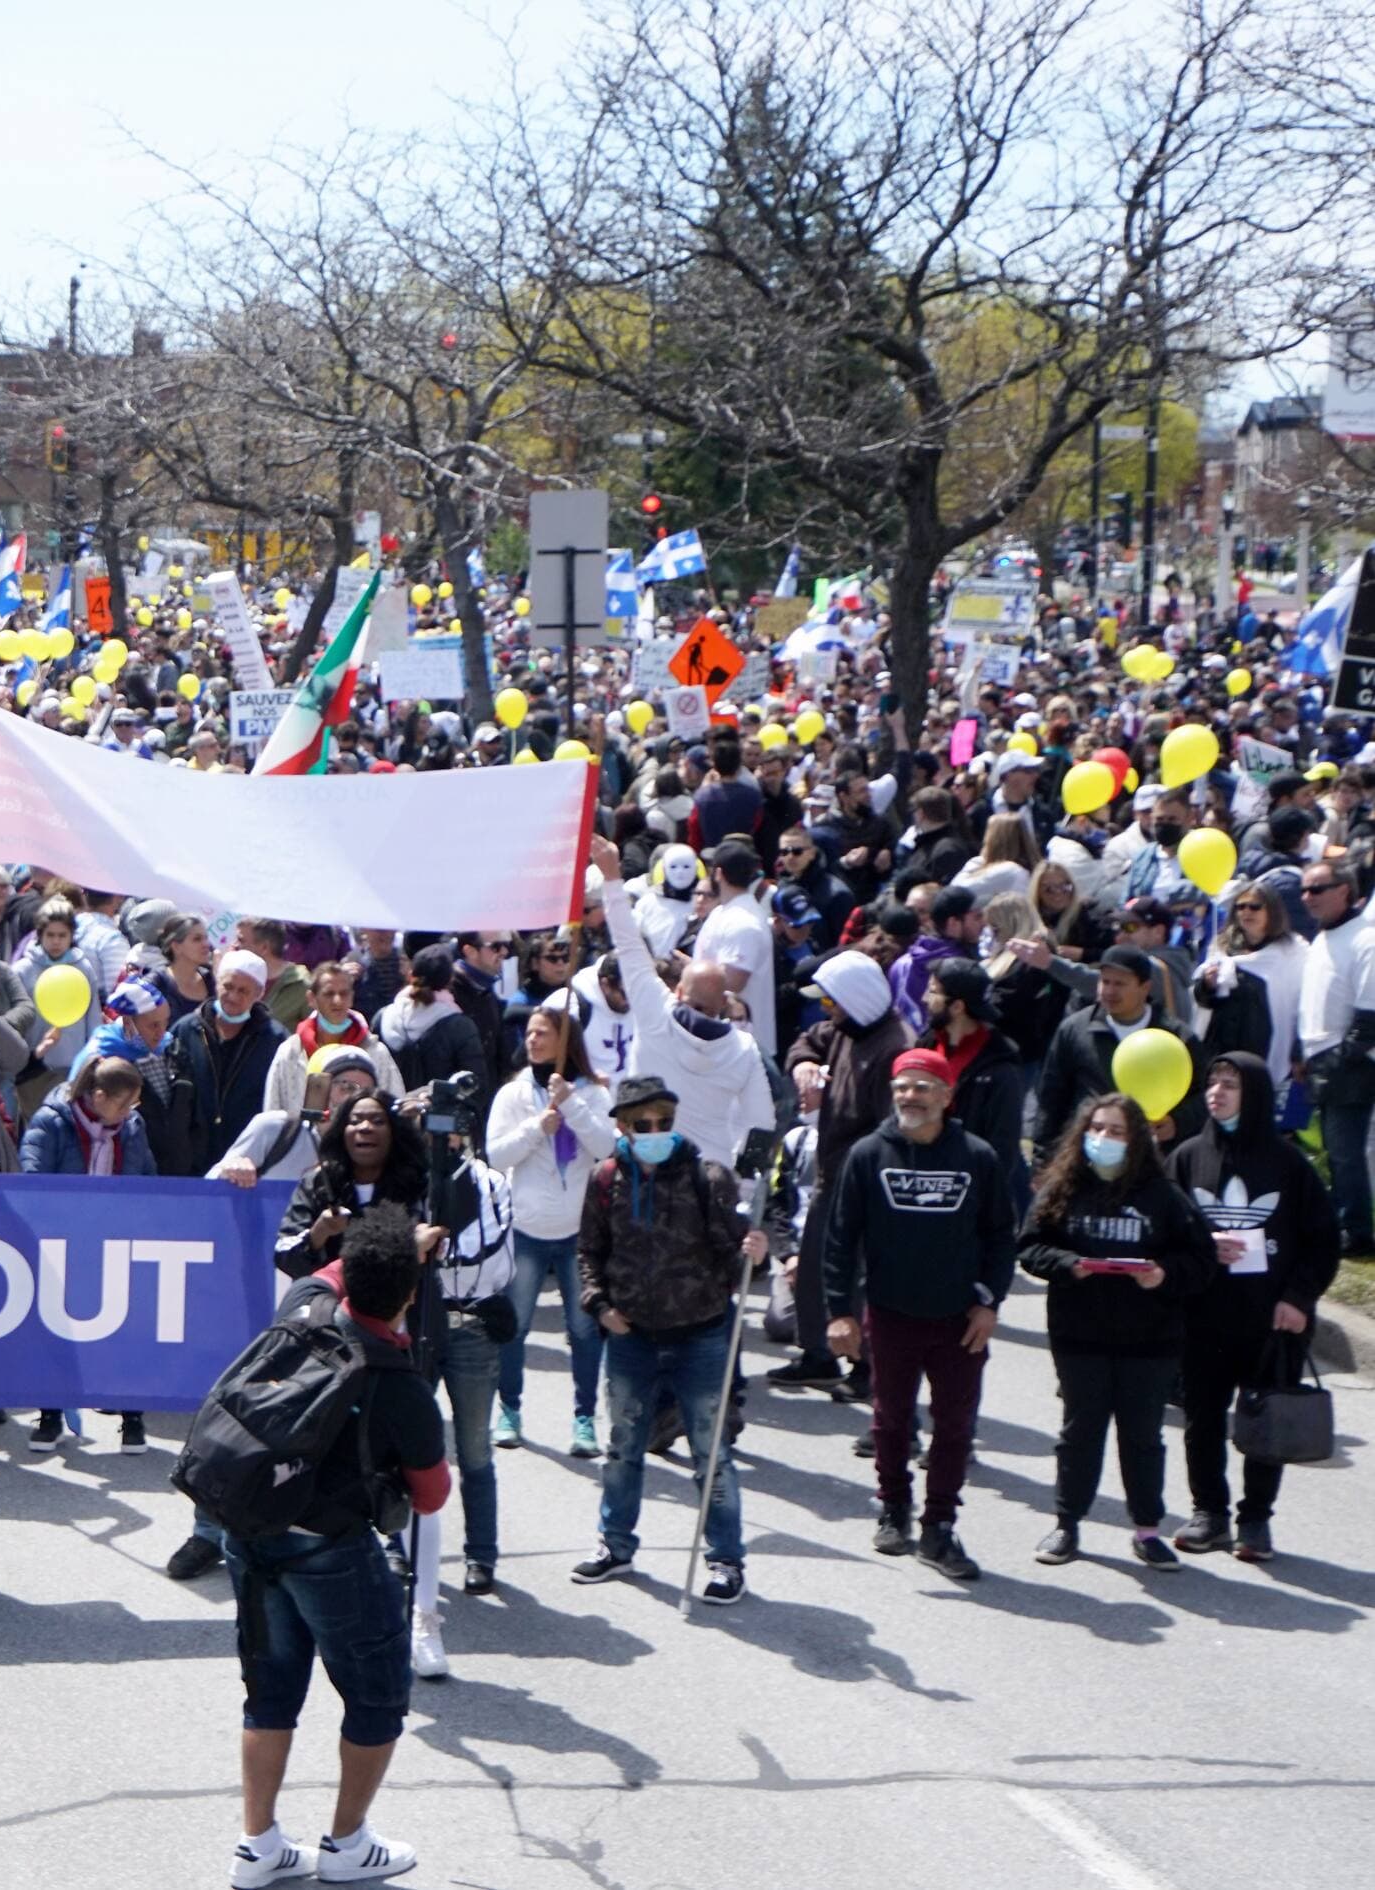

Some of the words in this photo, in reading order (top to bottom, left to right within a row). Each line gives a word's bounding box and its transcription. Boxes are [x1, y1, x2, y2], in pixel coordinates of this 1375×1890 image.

[1360, 667, 1375, 685] V
[236, 692, 293, 706] SAUVEZ
[253, 708, 277, 717] NOS
[245, 720, 278, 736] PM
[899, 1175, 955, 1192] VANS
